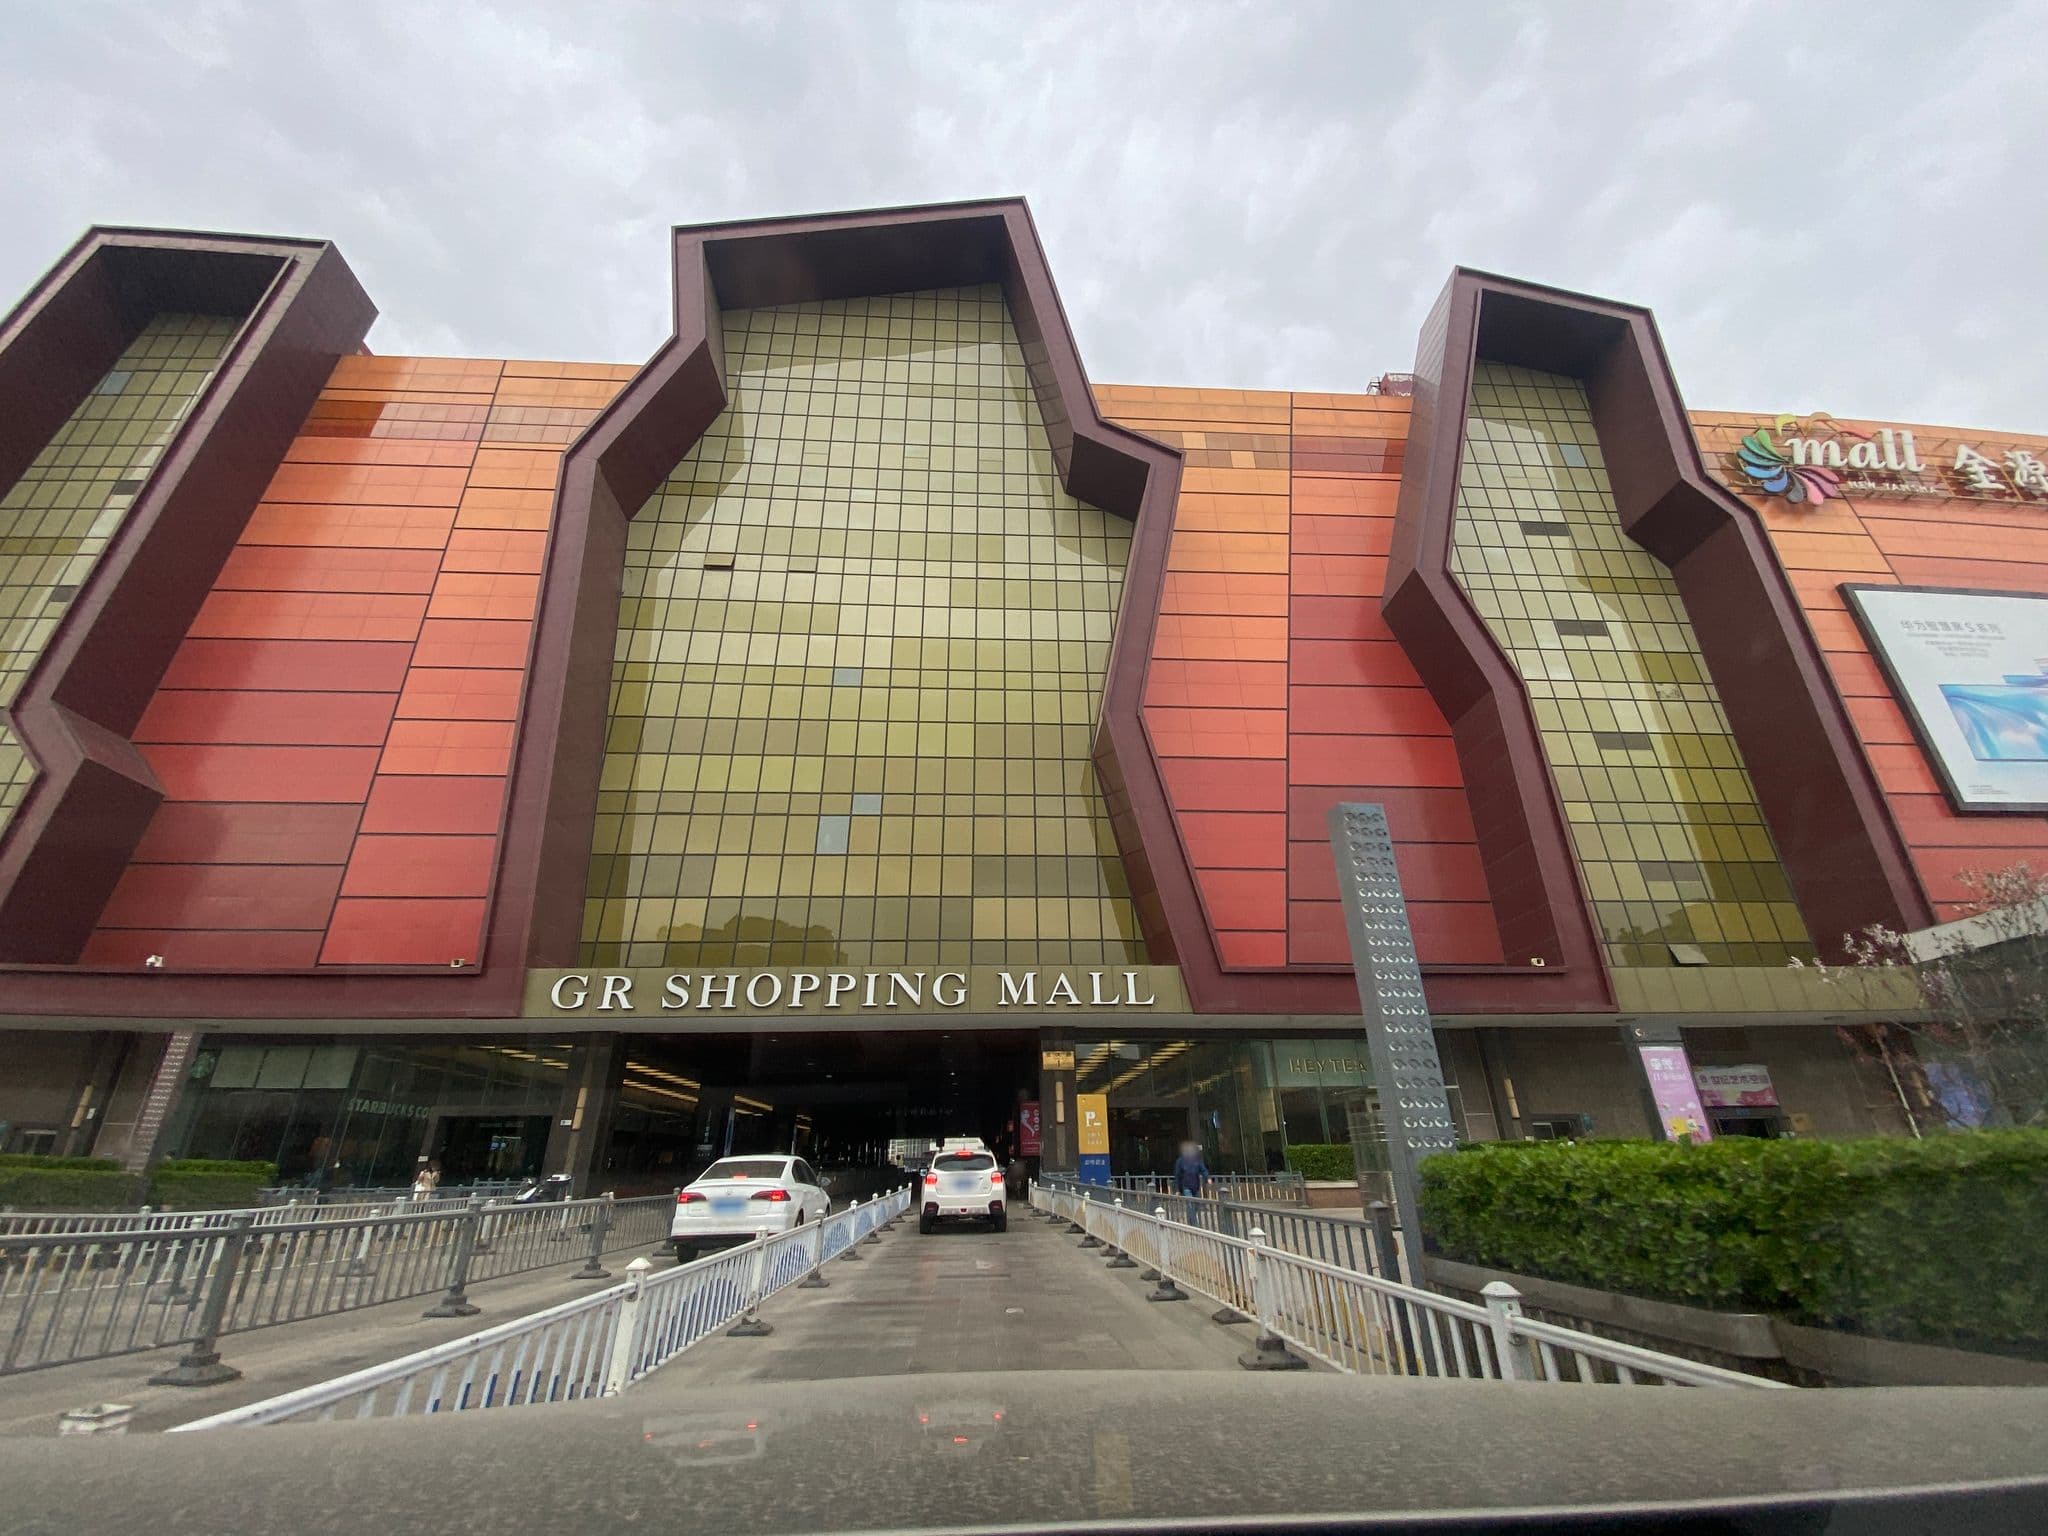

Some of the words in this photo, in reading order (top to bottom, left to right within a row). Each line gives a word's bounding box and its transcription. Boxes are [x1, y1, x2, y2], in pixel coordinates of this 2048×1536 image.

[1784, 428, 1926, 472] mall
[550, 974, 634, 1011] GR
[661, 973, 969, 1010] SHOPPING
[998, 971, 1157, 1008] MALL
[1289, 1058, 1368, 1073] HEYTEA
[347, 1098, 415, 1118] STARBUCKS
